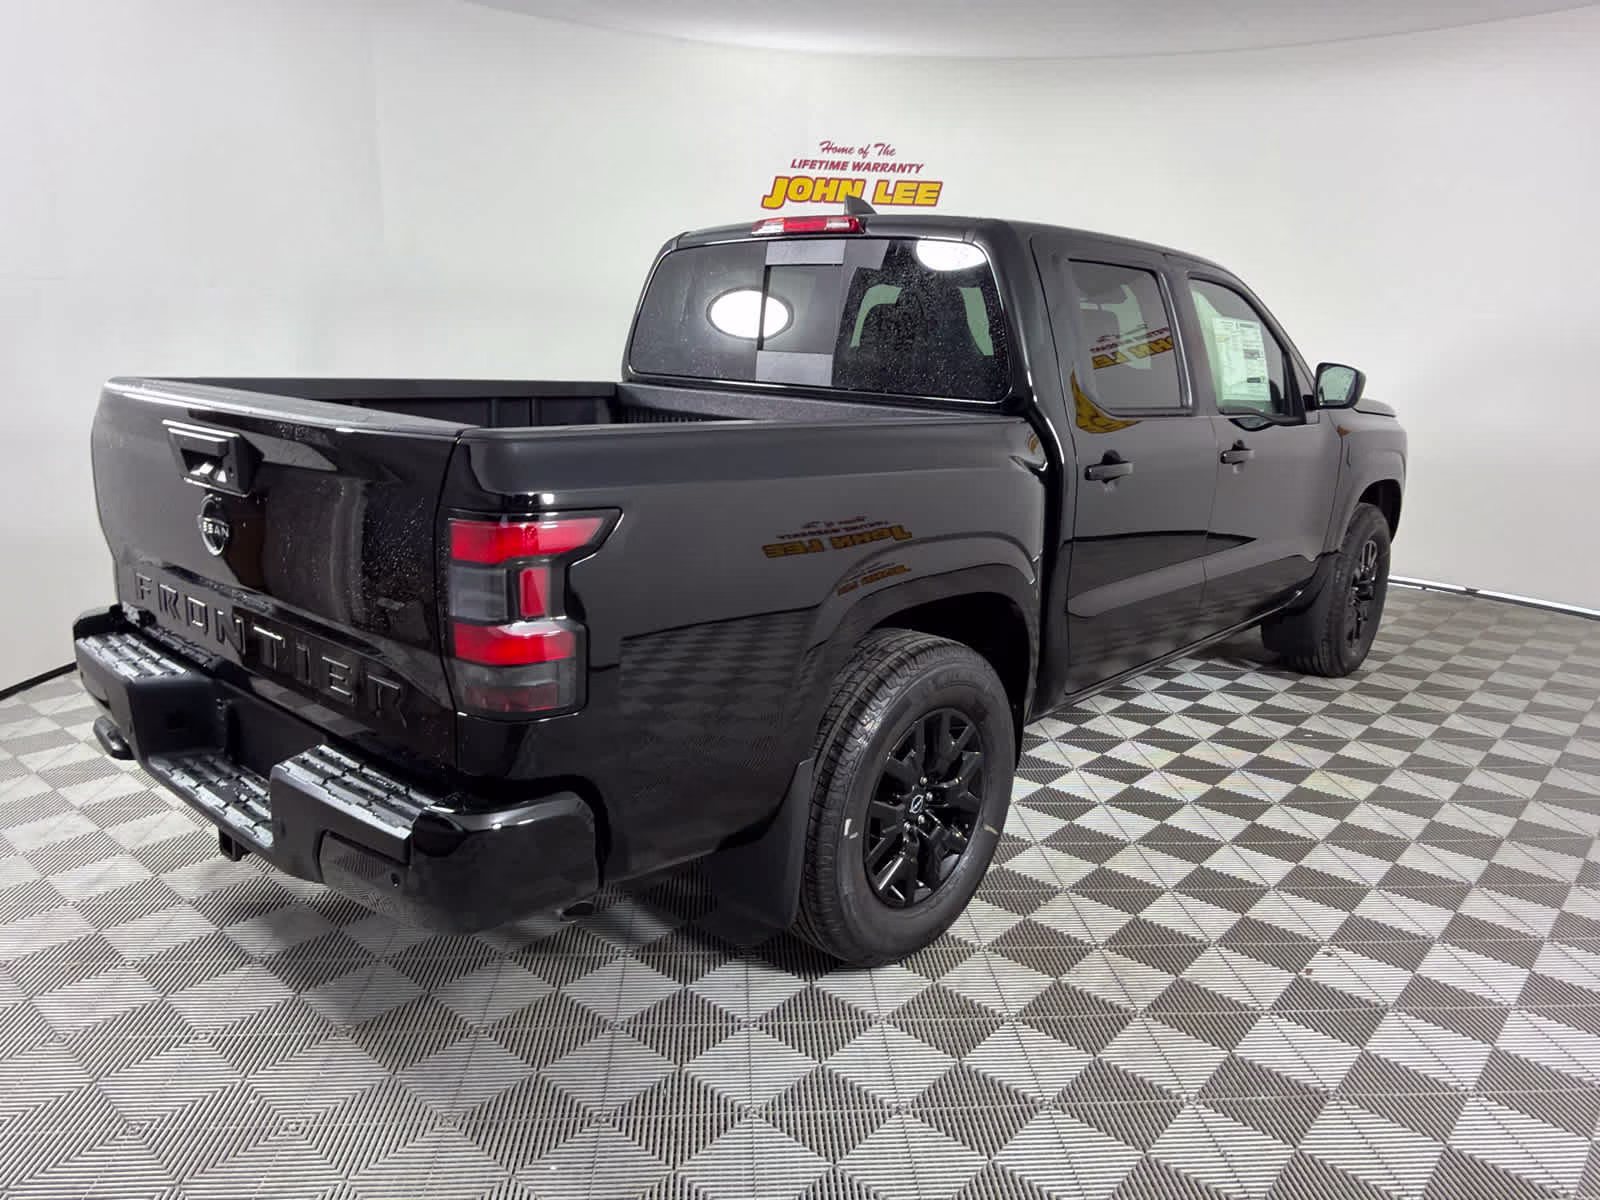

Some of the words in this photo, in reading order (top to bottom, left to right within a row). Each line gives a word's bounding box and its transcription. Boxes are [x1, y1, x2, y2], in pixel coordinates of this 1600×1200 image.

[820, 141, 854, 154] Home
[857, 143, 870, 158] of
[874, 142, 897, 157] The
[790, 159, 849, 171] LIFETIME
[852, 162, 924, 173] WARRANTY
[762, 176, 866, 209] JOHN
[872, 180, 943, 206] LEE
[135, 572, 409, 729] FRONTIER
